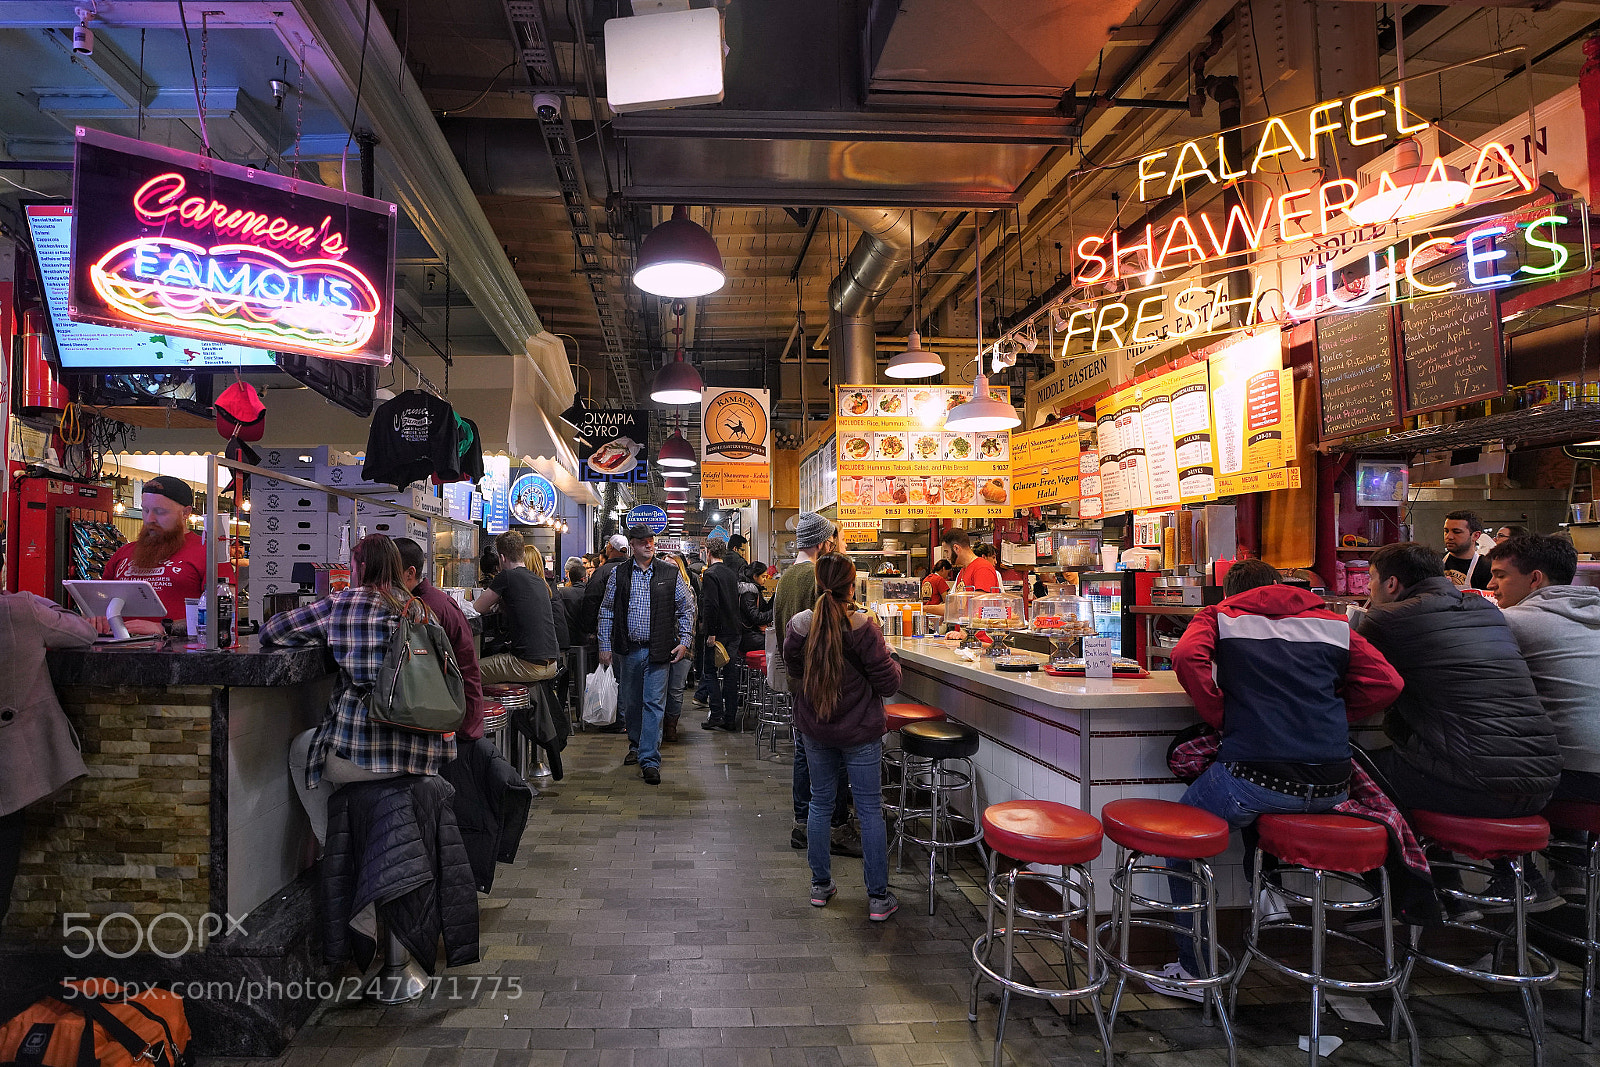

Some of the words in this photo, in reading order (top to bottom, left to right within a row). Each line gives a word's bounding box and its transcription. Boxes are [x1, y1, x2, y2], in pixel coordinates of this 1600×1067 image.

[1138, 85, 1430, 202] FALAFEL
[133, 172, 349, 255] Carmen's
[1282, 214, 1569, 316] JUICES
[134, 244, 353, 311] FAMOUS
[1466, 292, 1487, 308] Kale
[1061, 276, 1264, 357] FRESH
[1429, 318, 1460, 336] Banana
[1462, 304, 1489, 324] Carrot
[1446, 325, 1472, 344] Apple
[1321, 340, 1338, 352] Chia
[1322, 350, 1344, 364] Dates
[1377, 335, 1388, 346] .50
[1379, 347, 1390, 357] .50
[1428, 359, 1452, 374] Wheat
[1454, 354, 1477, 367] Grass
[1037, 376, 1065, 404] MIDDLE
[1068, 356, 1108, 388] EASTERN
[1381, 371, 1391, 381] .50
[716, 395, 755, 408] KAMAL'S
[874, 408, 879, 417] 2
[909, 407, 914, 416] 3
[584, 412, 635, 426] OLYMPIA
[583, 425, 619, 438] GYRO
[841, 452, 846, 460] 6
[875, 450, 880, 458] 7
[910, 452, 915, 460] 8
[944, 451, 949, 459] 9
[976, 452, 983, 460] 10
[1267, 471, 1282, 480] LARGE
[1012, 478, 1057, 491] Gluten-Free,
[1057, 474, 1079, 486] Vegan
[1037, 487, 1058, 499] Halal
[1084, 639, 1107, 648] Assorted
